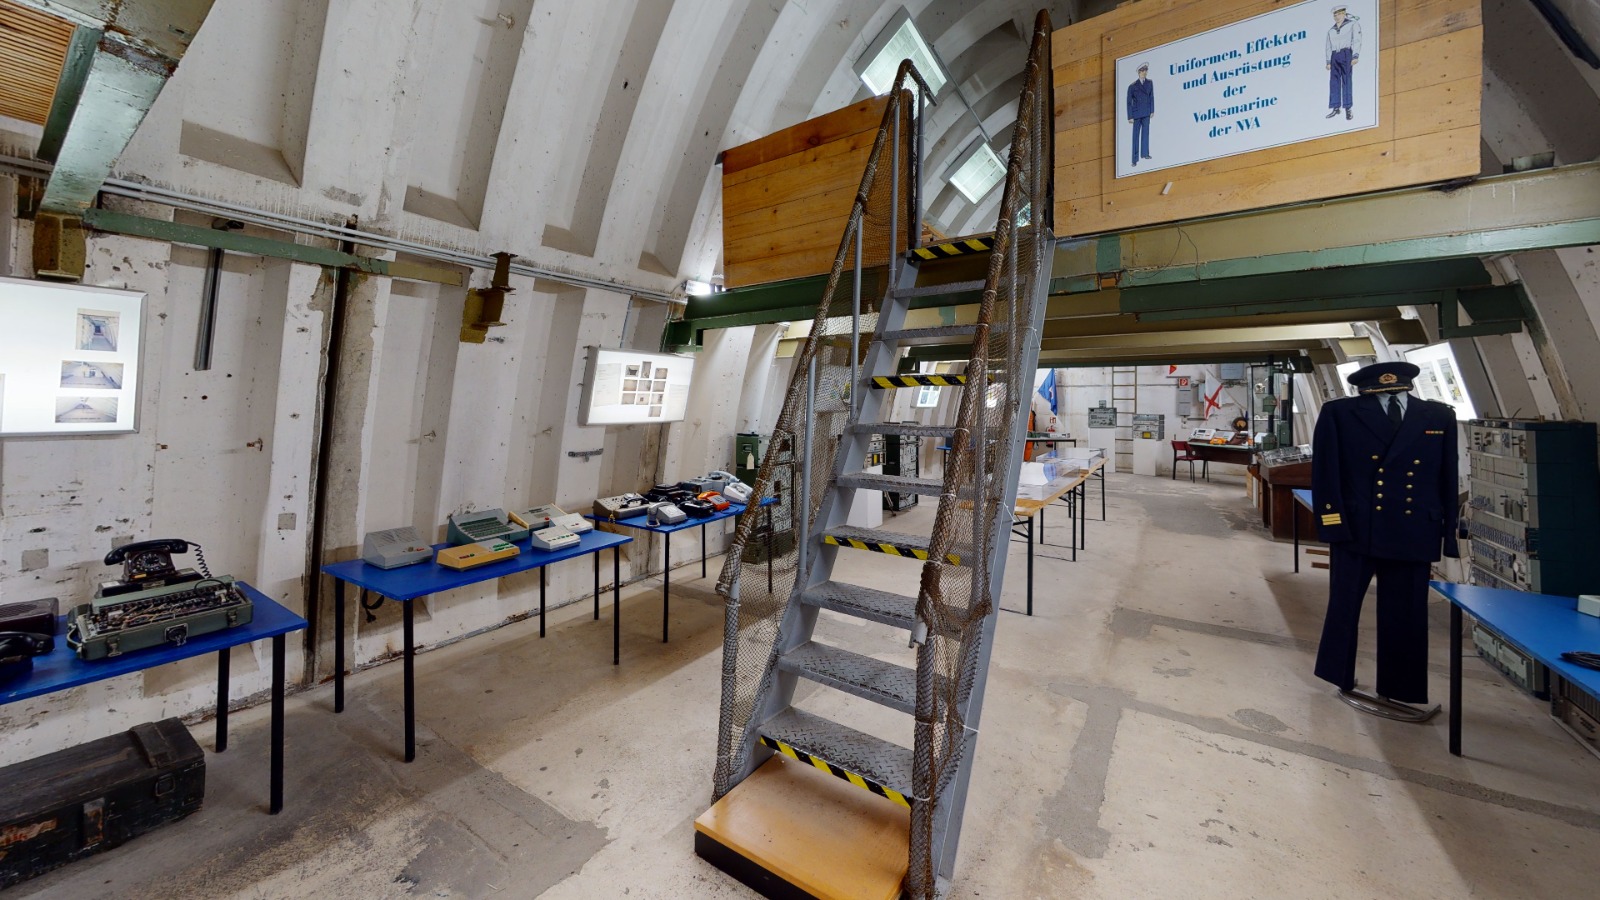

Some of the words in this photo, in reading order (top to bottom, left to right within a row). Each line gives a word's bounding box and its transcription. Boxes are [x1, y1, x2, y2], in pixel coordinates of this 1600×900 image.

[1169, 49, 1242, 76] Uniformen,
[1246, 30, 1307, 55] Effekten
[1183, 73, 1207, 90] und
[1210, 53, 1292, 83] Ausrüstung
[1223, 85, 1247, 98] der
[1193, 96, 1278, 123] Volksmarine
[1208, 125, 1232, 138] der
[1235, 116, 1261, 132] NVA
